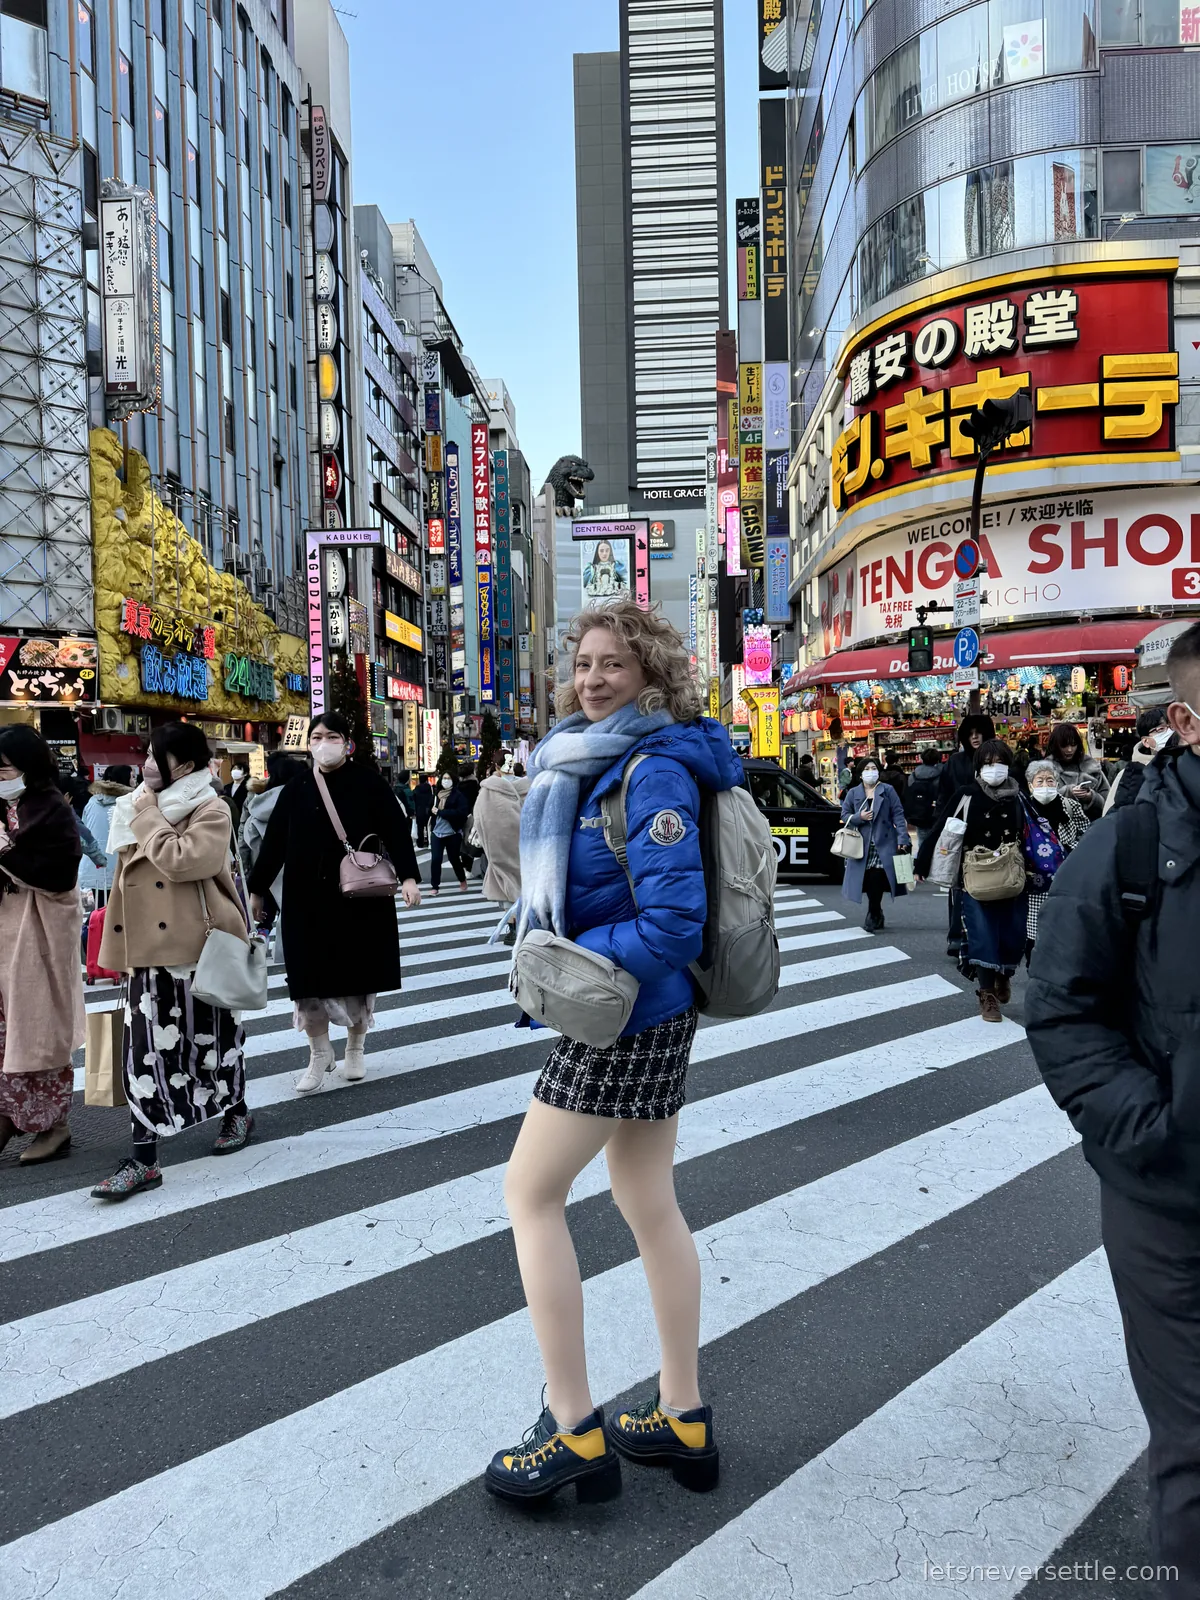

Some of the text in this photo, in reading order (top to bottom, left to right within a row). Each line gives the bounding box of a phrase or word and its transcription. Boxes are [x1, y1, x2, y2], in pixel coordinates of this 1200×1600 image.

[906, 82, 938, 120] LIVE
[849, 289, 1079, 405] 驚安の殿堂
[116, 356, 127, 370] 光
[746, 367, 756, 403] 生ビール
[745, 433, 762, 443] 4F
[473, 429, 489, 544] カラオケ歌広場
[643, 490, 672, 499] HOTEL
[1020, 499, 1094, 522] 欢迎光临
[879, 600, 913, 613] TAX FREE
[885, 615, 903, 628] 免税
[308, 563, 323, 709] GODZILLA ROA
[959, 638, 968, 662] P
[142, 644, 208, 701] 飲み放題
[753, 691, 777, 699] カラオケ
[655, 828, 681, 842] MONCLER
